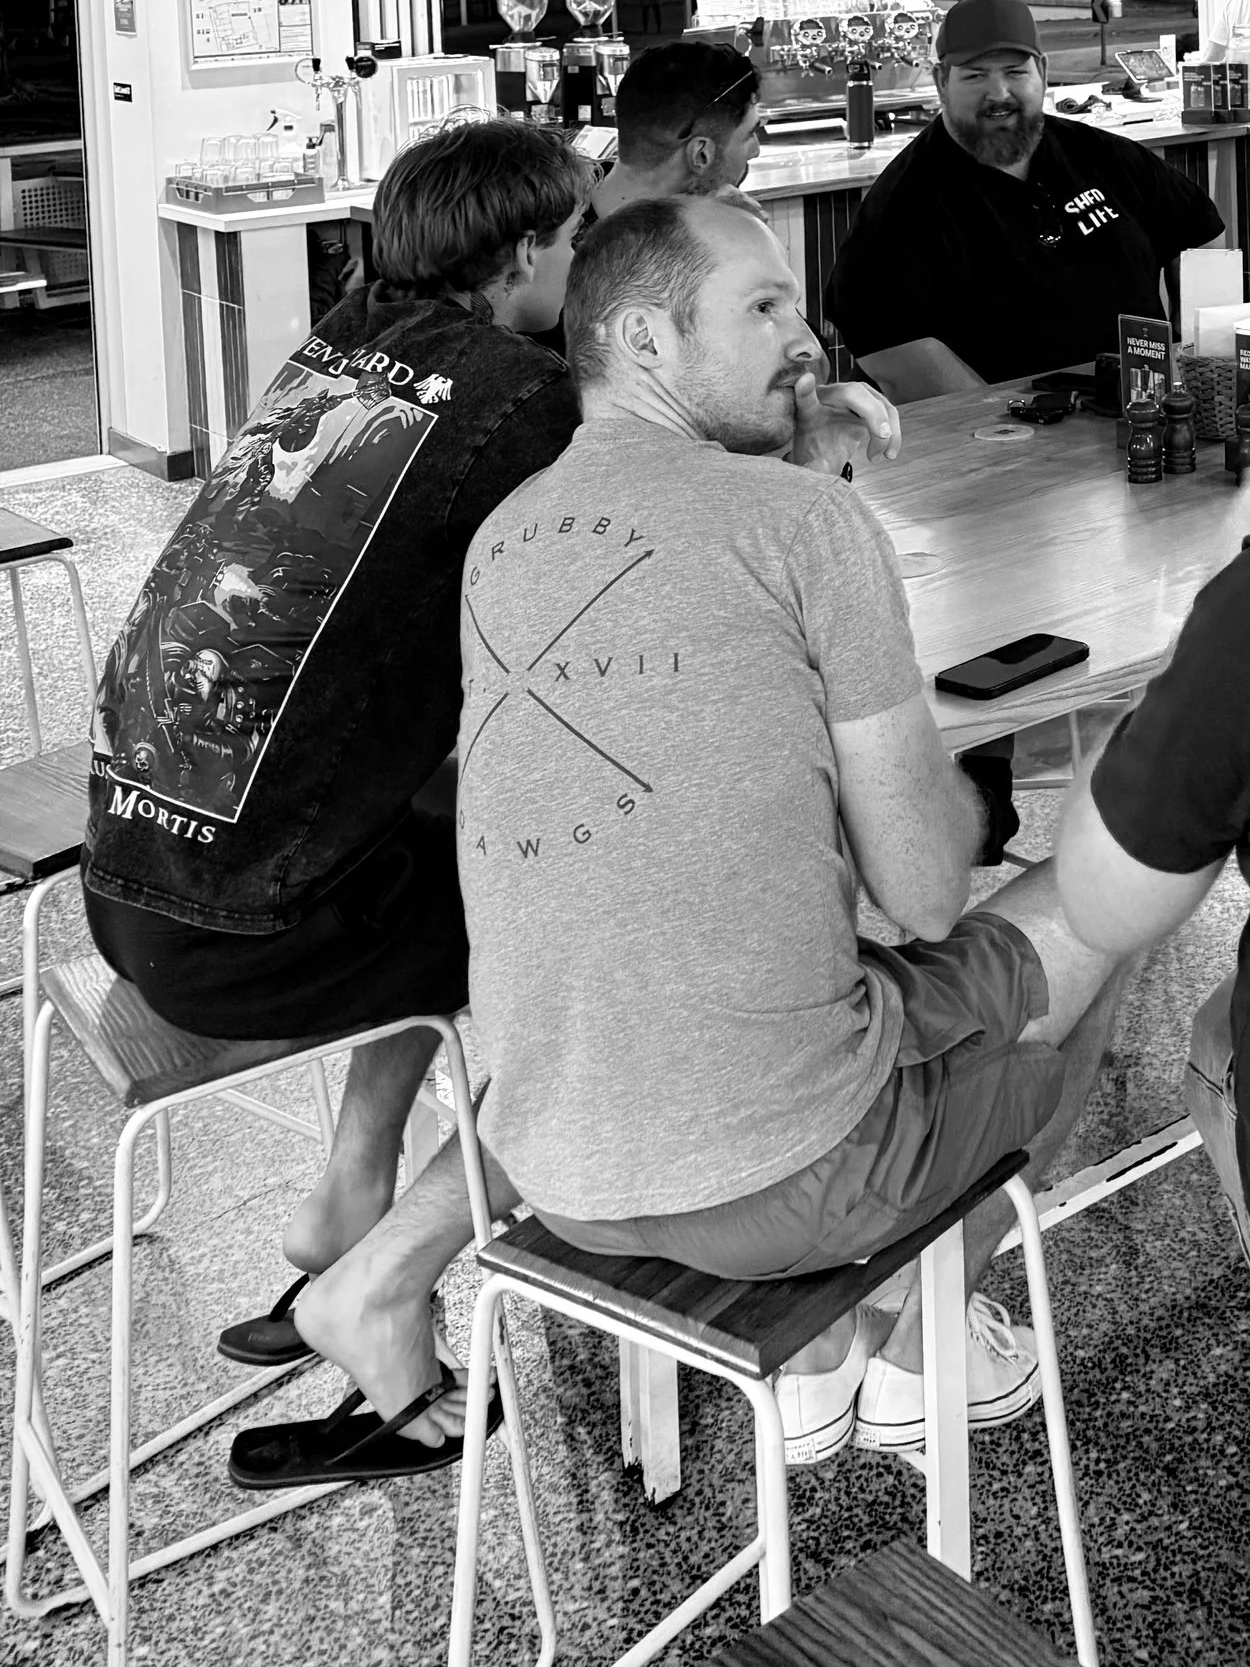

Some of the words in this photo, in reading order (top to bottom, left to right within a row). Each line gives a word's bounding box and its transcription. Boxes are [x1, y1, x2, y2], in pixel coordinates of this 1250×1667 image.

[1064, 188, 1105, 214] SHED
[1077, 205, 1119, 236] LIFE
[1126, 336, 1149, 349] NEVER
[1149, 341, 1166, 352] MISS
[1127, 346, 1133, 354] A
[1133, 347, 1166, 361] MOMENT
[1240, 349, 1250, 357] RED
[469, 517, 645, 586] GRUBBY
[554, 652, 681, 682] XVII
[458, 792, 637, 860] DAWGS
